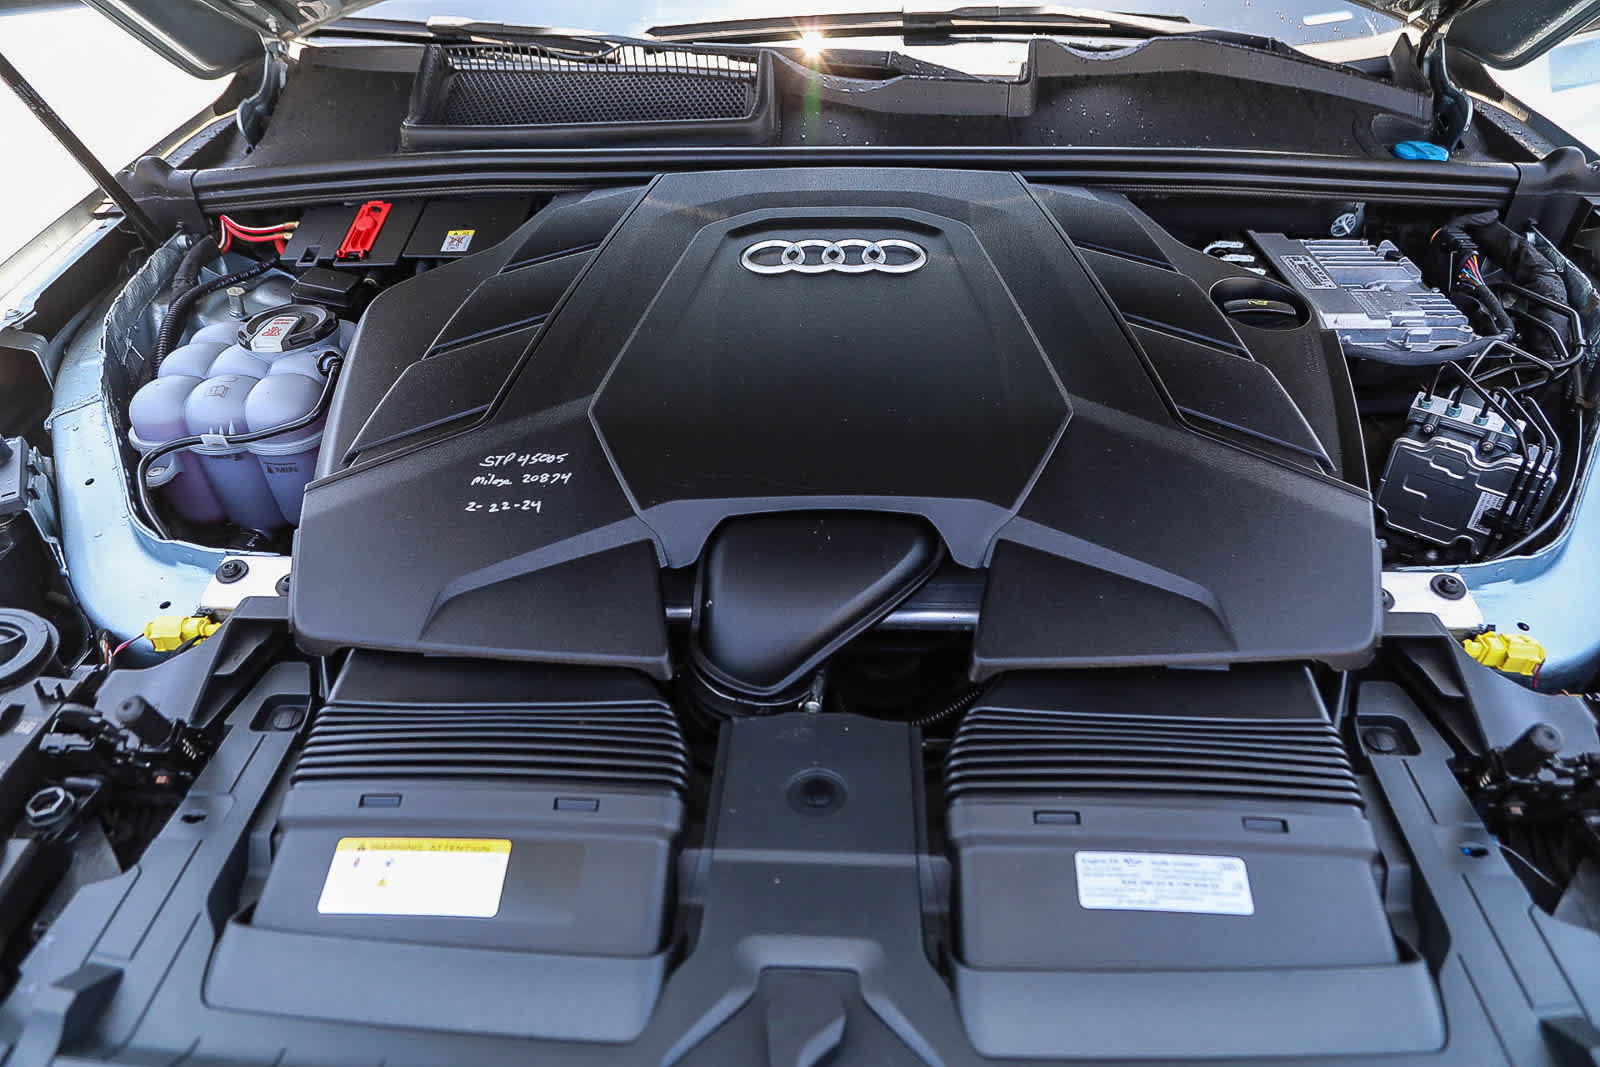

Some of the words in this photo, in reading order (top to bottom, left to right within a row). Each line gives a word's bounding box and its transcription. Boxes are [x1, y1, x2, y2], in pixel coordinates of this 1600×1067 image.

[479, 452, 517, 467] STP
[522, 472, 573, 485] 20874
[464, 499, 542, 514] 2-22-24
